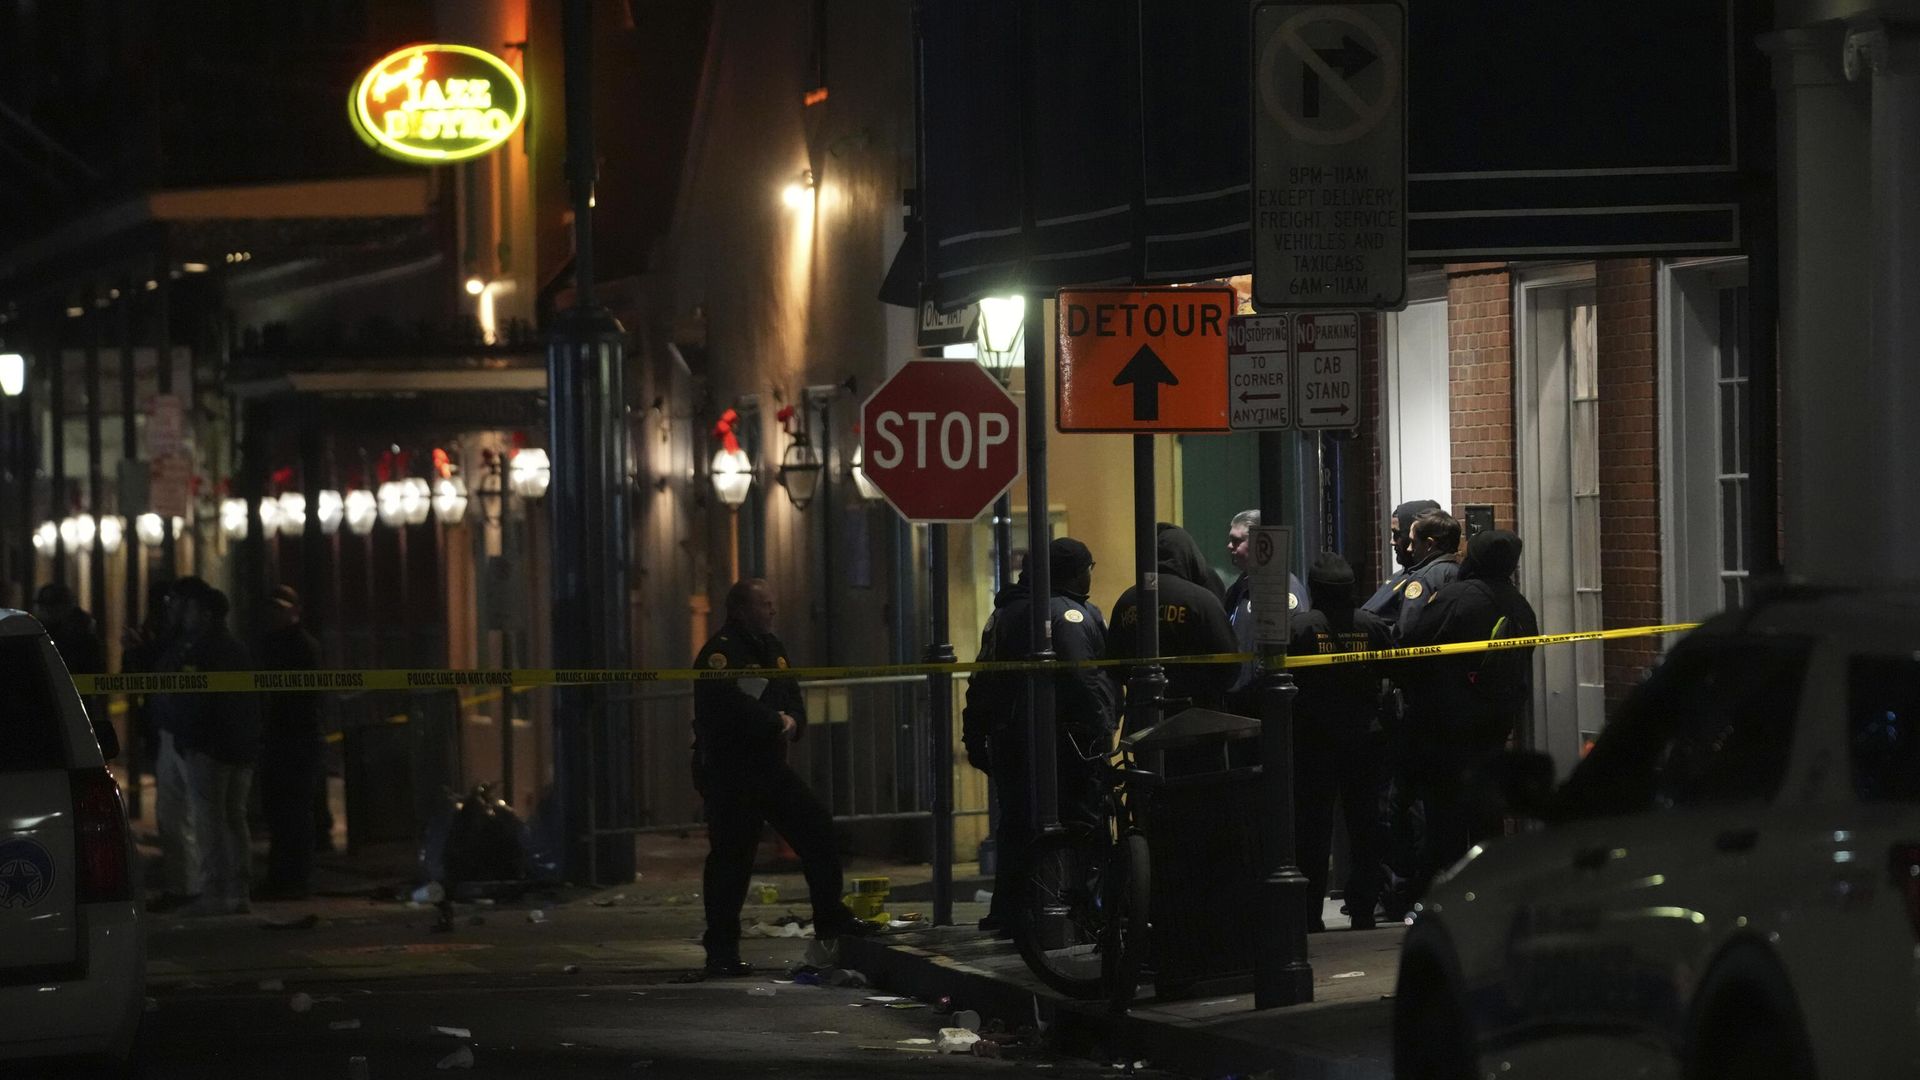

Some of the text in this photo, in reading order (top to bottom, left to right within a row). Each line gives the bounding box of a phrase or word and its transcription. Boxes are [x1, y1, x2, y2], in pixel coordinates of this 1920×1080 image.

[400, 78, 492, 112] JAZZ
[1258, 189, 1315, 207] EXCEPT
[1334, 211, 1397, 228] SERVICE
[1273, 233, 1385, 250] VEHICLES AND
[1294, 255, 1365, 272] TAXICABS
[1067, 303, 1223, 338] DETOUR
[1228, 323, 1287, 347] NO STOPPING
[1297, 323, 1356, 345] NO PARKING
[1250, 356, 1266, 369] TO
[1314, 356, 1341, 375] CAB
[1234, 373, 1284, 387] CORNER
[1305, 382, 1350, 400] STAND
[1233, 407, 1287, 423] ANYTIME
[873, 411, 1010, 470] STOP
[1394, 649, 1411, 658] NOT
[1413, 647, 1442, 656] CROSS
[94, 675, 208, 691] POLICE LINE DO NOT CROSS
[254, 673, 364, 689] POLICE LINE DO NOT CROSS
[407, 672, 512, 686] POLICE LINE DO NOT CROSS
